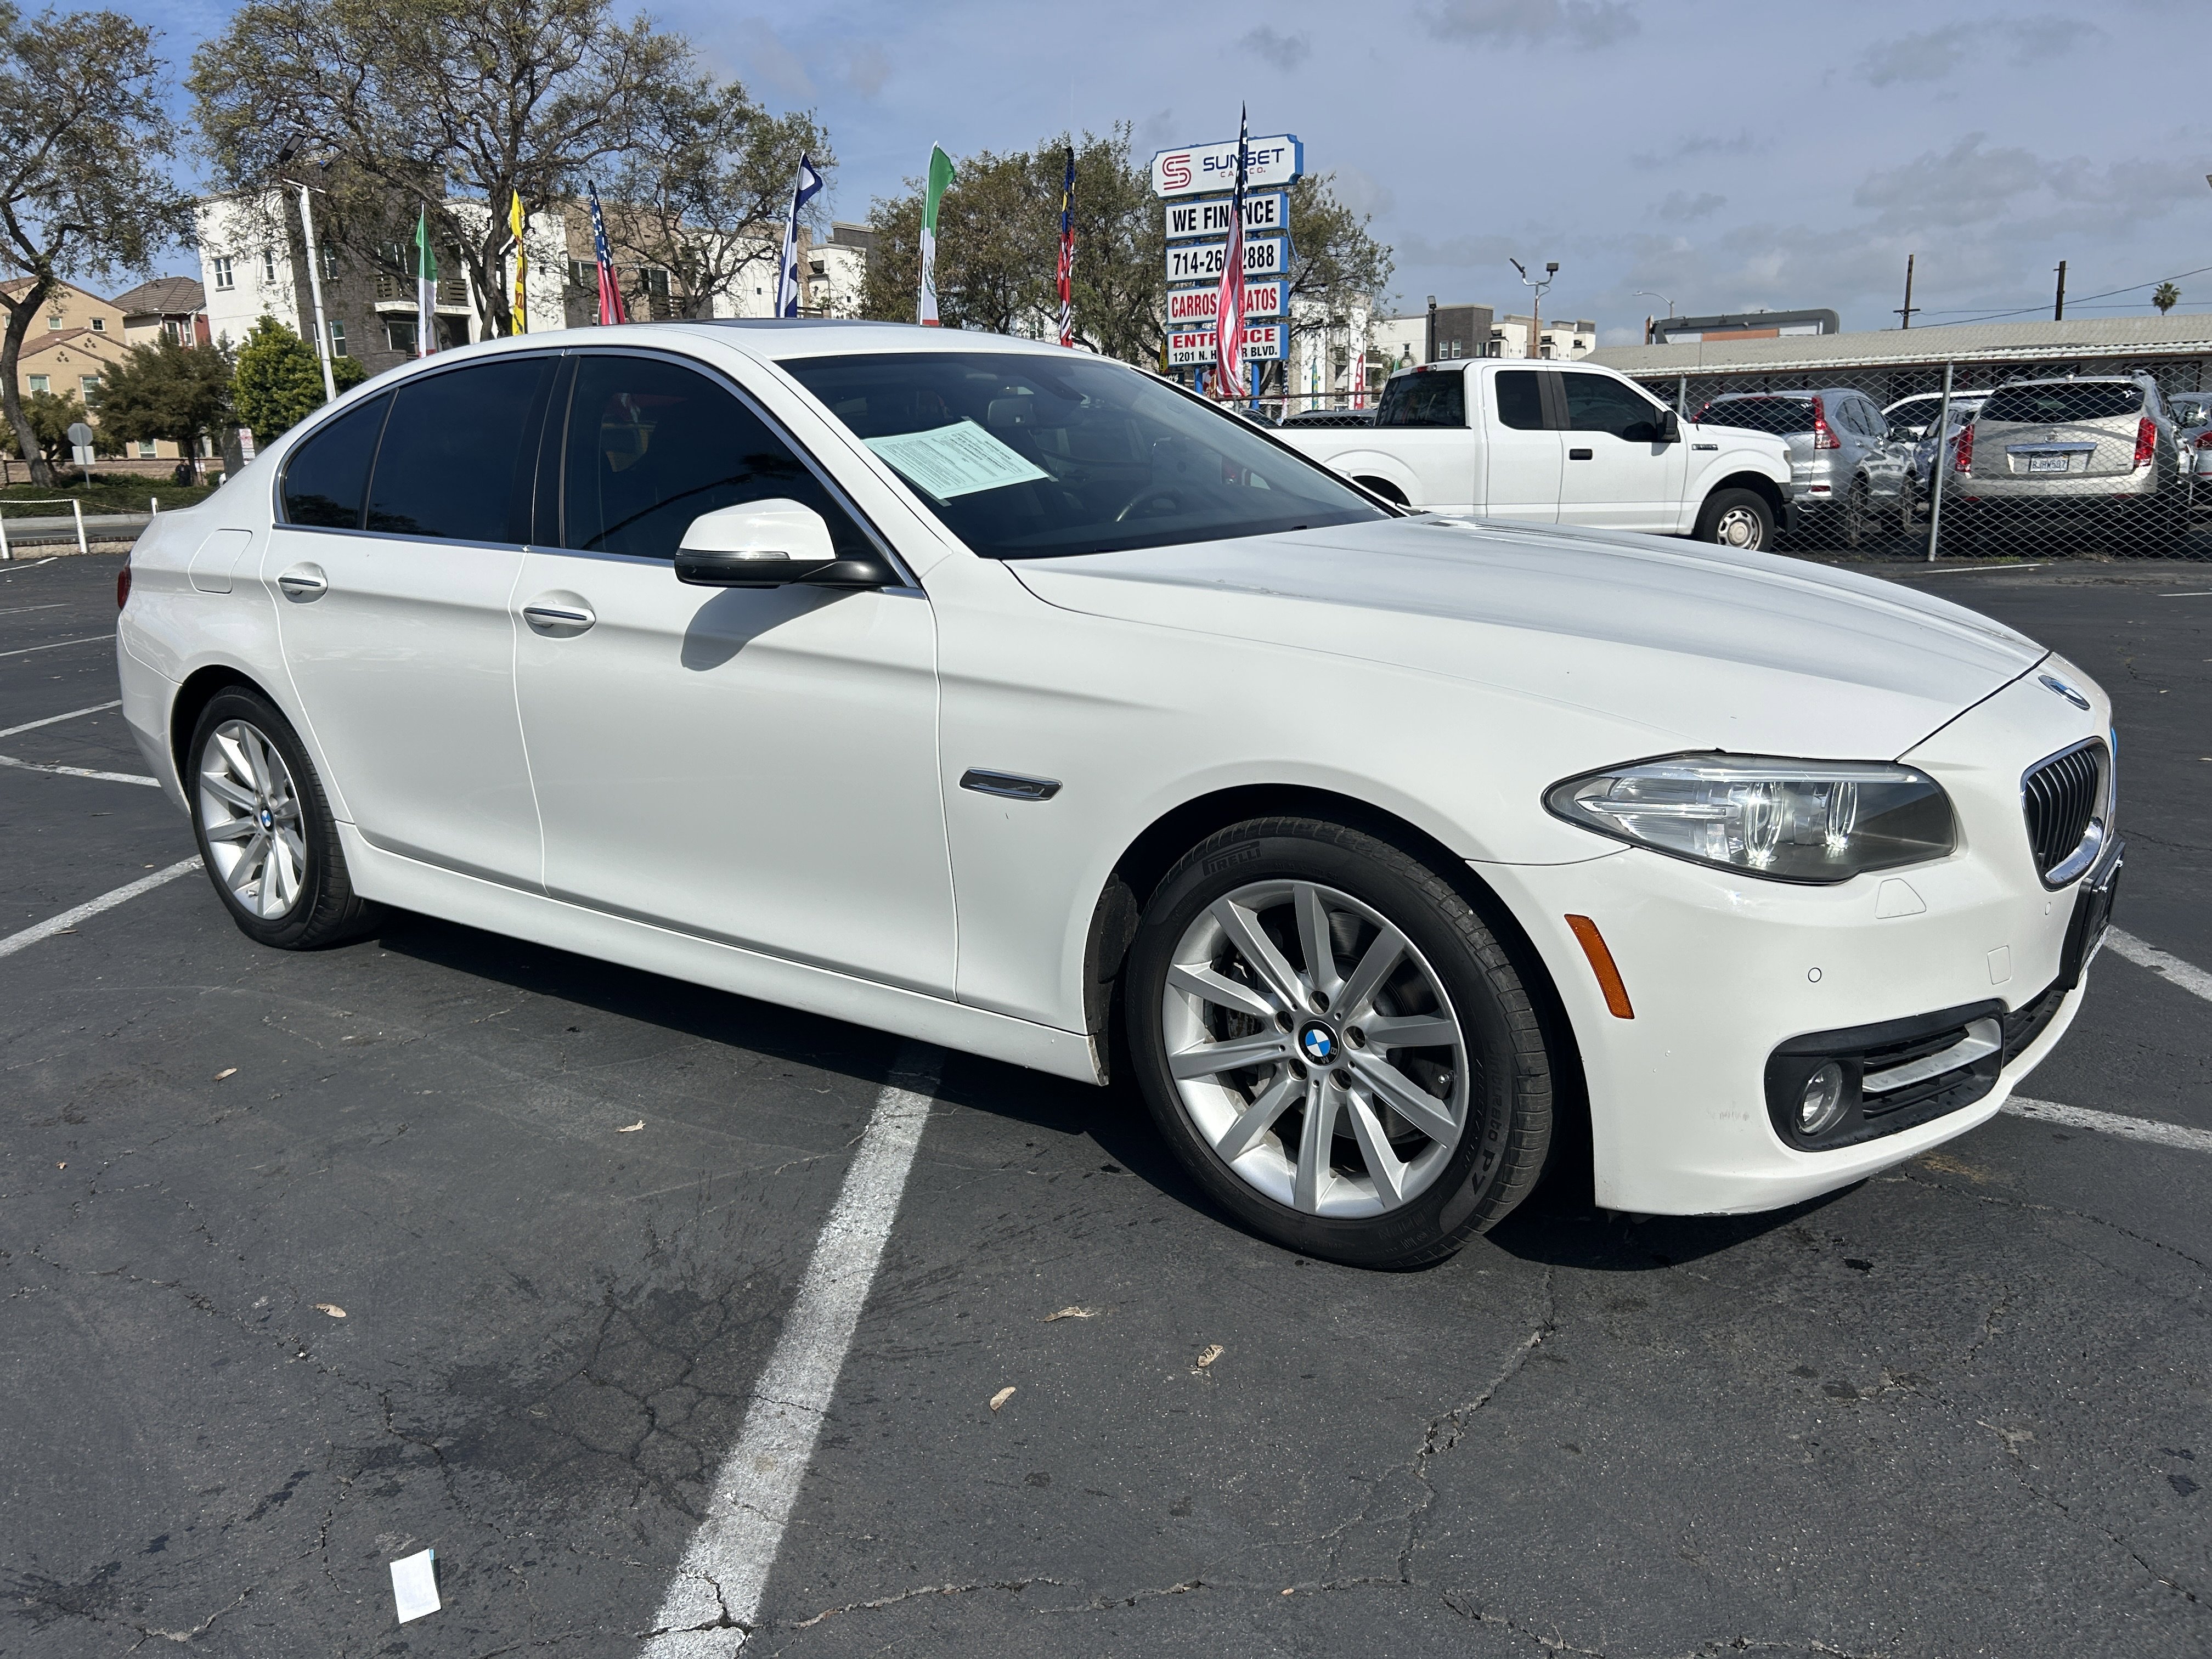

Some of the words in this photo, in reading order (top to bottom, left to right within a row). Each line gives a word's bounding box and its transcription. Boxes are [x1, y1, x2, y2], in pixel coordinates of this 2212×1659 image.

[1203, 148, 1285, 172] SUNSET
[1172, 208, 1197, 232] WE
[1204, 200, 1274, 229] FINNCE
[1173, 245, 1274, 275] 714-26888
[1171, 293, 1217, 318] CARROS
[1173, 328, 1275, 349] ENTRCE
[1173, 351, 1194, 362] 1201
[1199, 351, 1207, 360] N.
[1251, 345, 1278, 357] BLVD.
[1202, 840, 1261, 877] PIRELLI
[1307, 1046, 1338, 1064] BMW
[1471, 1148, 1496, 1195] P7
